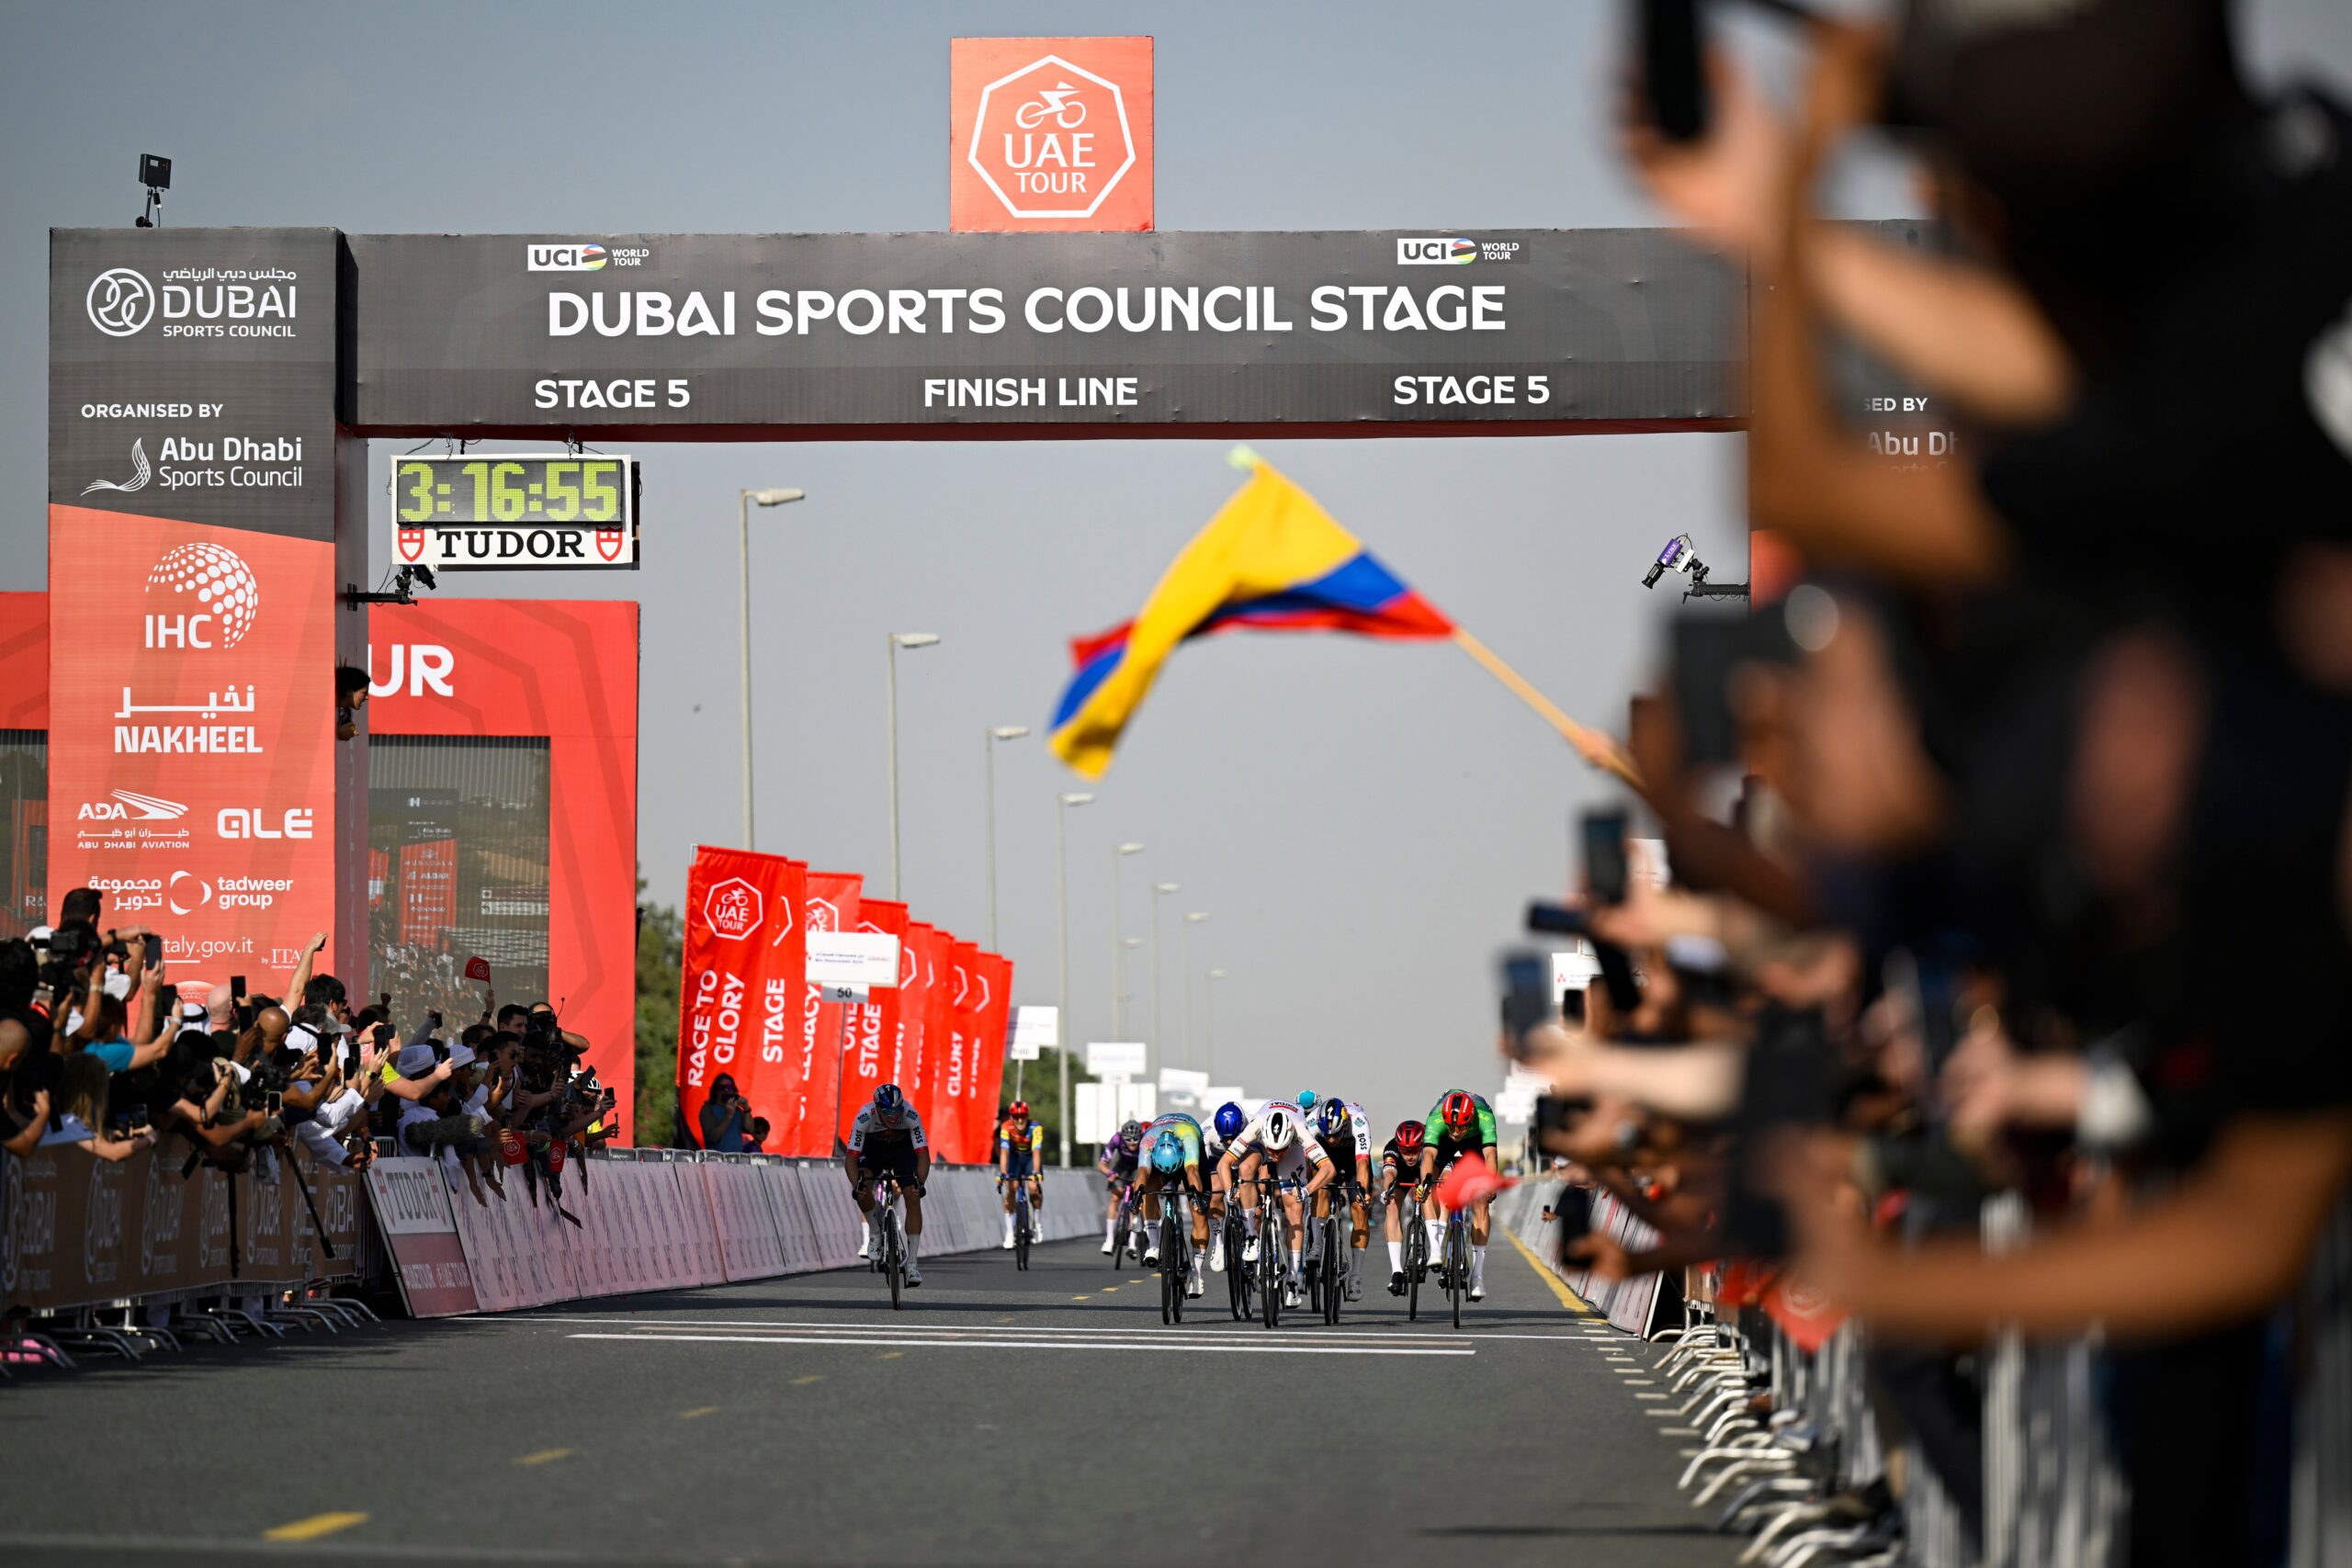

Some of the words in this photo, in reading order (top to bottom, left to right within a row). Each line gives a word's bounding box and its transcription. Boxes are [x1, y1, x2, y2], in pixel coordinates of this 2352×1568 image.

[1003, 132, 1096, 168] UAE
[1014, 171, 1087, 194] TOUR
[611, 248, 650, 257] WORLD
[1404, 243, 1447, 260] UCI
[1481, 242, 1520, 252] WORLD
[534, 249, 578, 266] UCI
[613, 257, 642, 266] TOUR
[1482, 252, 1512, 261] TOUR
[163, 267, 215, 281] الرياضي
[217, 268, 246, 281] دبي
[248, 268, 297, 281] مجلس
[162, 286, 296, 319] DUBAI
[548, 289, 736, 337] DUBAI
[755, 287, 1007, 336] SPORTS
[1024, 285, 1294, 333] COUNCIL
[1309, 284, 1507, 332] STAGE
[163, 324, 224, 337] SPORTS
[229, 324, 296, 337] COUNCIL
[535, 378, 657, 409] STAGE
[667, 378, 691, 409] 5
[924, 377, 1046, 408] FINISH
[1057, 377, 1139, 407] LINE
[1393, 375, 1516, 405] STAGE
[1527, 376, 1550, 405] 5
[81, 403, 193, 419] ORGANISED
[198, 404, 224, 418] BY
[1903, 397, 1928, 412] BY
[160, 437, 214, 462] Abu
[223, 437, 302, 461] Dhabi
[159, 466, 224, 491] Sports
[230, 466, 302, 487] Council
[398, 462, 618, 523] 3:16:55
[436, 530, 585, 558] TUDOR
[145, 614, 212, 649] IHC
[368, 643, 455, 698] UR
[114, 726, 264, 753] NAKHEEL
[77, 802, 129, 820] ADA
[77, 840, 99, 850] ABU
[104, 840, 137, 850] DHABI
[141, 840, 190, 850] AVIATION
[87, 875, 163, 894] مجموعة
[218, 875, 294, 892] tadweer
[114, 893, 163, 911] تدوير
[219, 893, 274, 909] group
[716, 905, 750, 923] UAE
[718, 919, 744, 932] TOUR
[162, 935, 254, 958] taly.gov.it
[271, 948, 304, 964] ITA
[695, 969, 718, 1009] TO
[837, 987, 853, 999] 50
[713, 971, 746, 1065] GLORY
[762, 977, 786, 1064] STAGE
[858, 1002, 882, 1078] STAGE
[687, 1014, 712, 1088] RACE
[854, 1129, 863, 1147] BOSS
[912, 1126, 924, 1145] BOSS
[1357, 1133, 1368, 1151] BOSS
[385, 1170, 438, 1221] TUDOR
